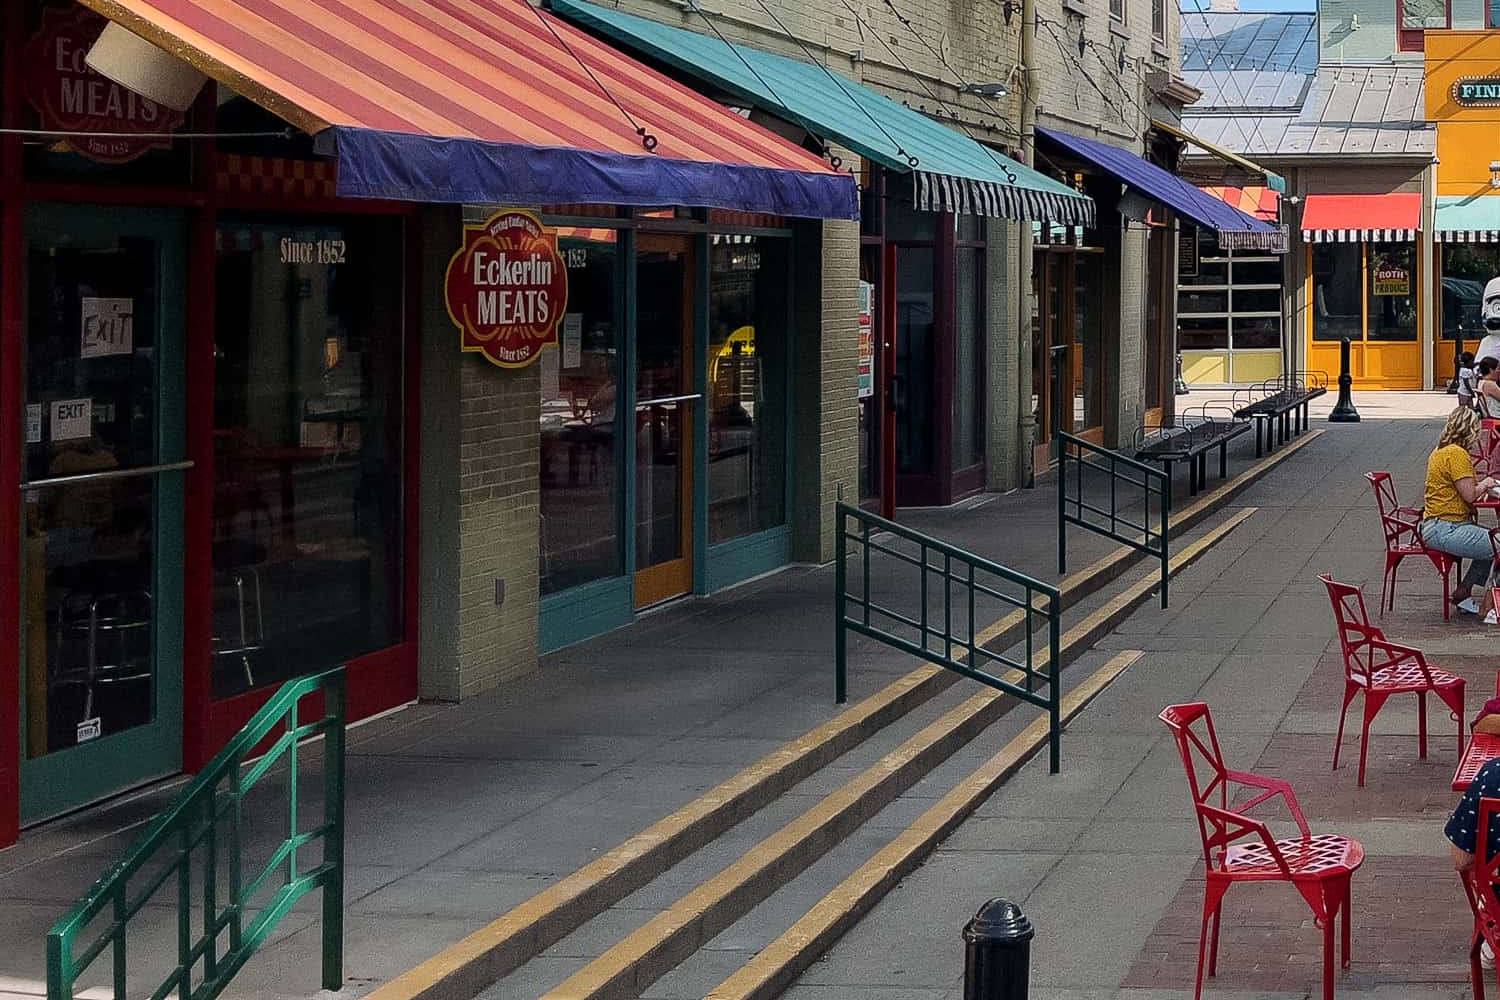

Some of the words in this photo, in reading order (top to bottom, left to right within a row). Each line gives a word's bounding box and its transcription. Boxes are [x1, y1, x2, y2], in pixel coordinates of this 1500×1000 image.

[280, 237, 314, 264] Since
[316, 239, 346, 264] 1852
[473, 251, 552, 286] Eckerlin
[477, 290, 549, 325] MEATS
[82, 312, 132, 348] EXIT
[499, 345, 515, 360] Since
[57, 403, 86, 420] EXIT
